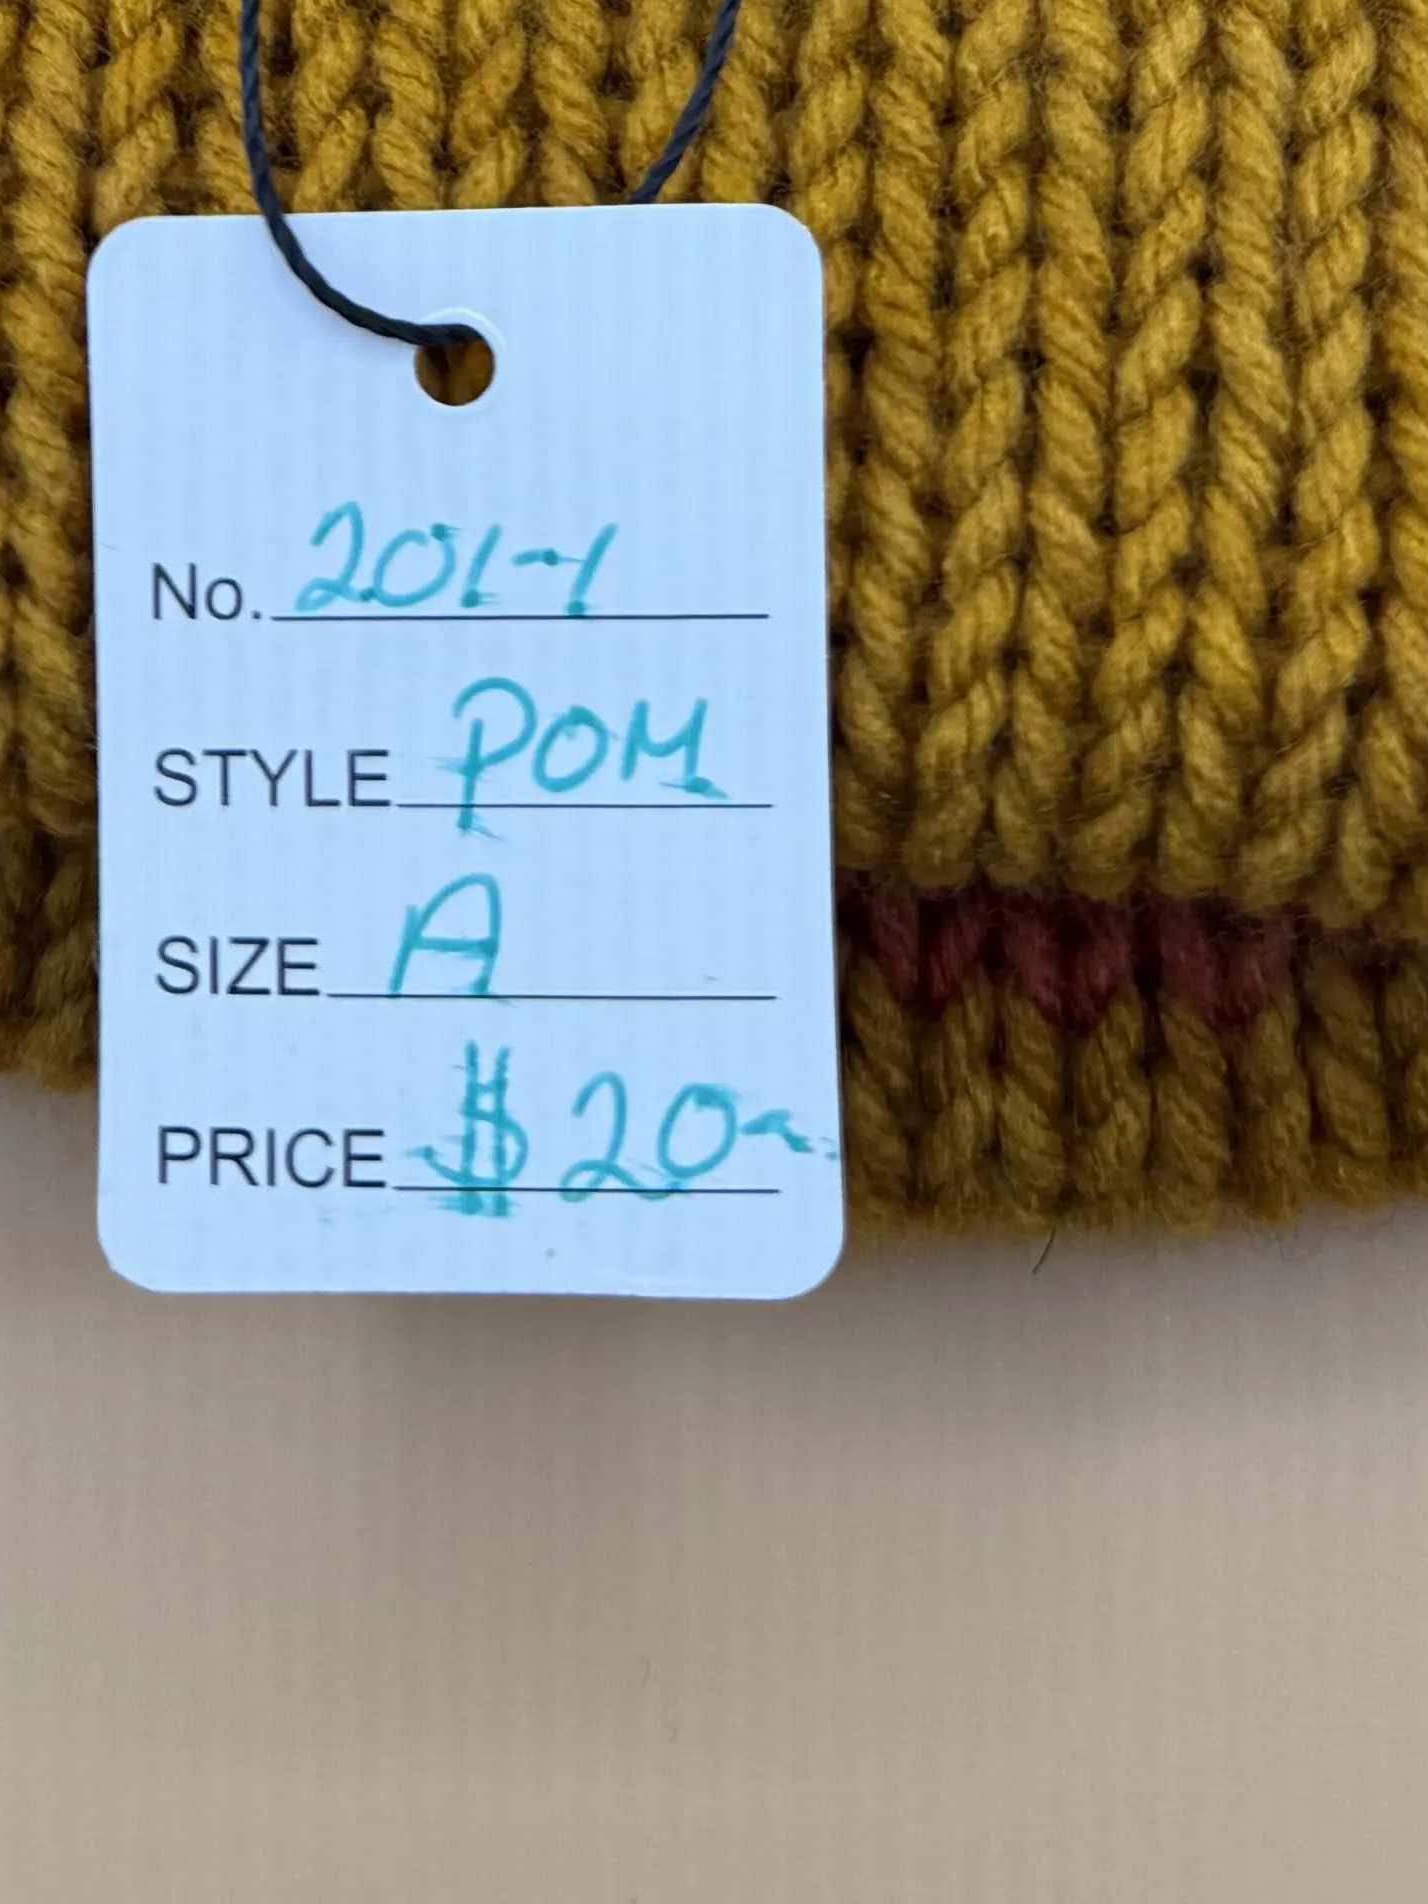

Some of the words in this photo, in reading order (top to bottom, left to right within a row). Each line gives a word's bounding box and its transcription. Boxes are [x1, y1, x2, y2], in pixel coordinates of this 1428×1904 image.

[150, 562, 264, 622] No.
[153, 747, 391, 809] STYLE
[440, 676, 729, 837] POM
[155, 935, 319, 997] SIZE
[387, 872, 502, 1000] A
[157, 1125, 387, 1189] PRICE
